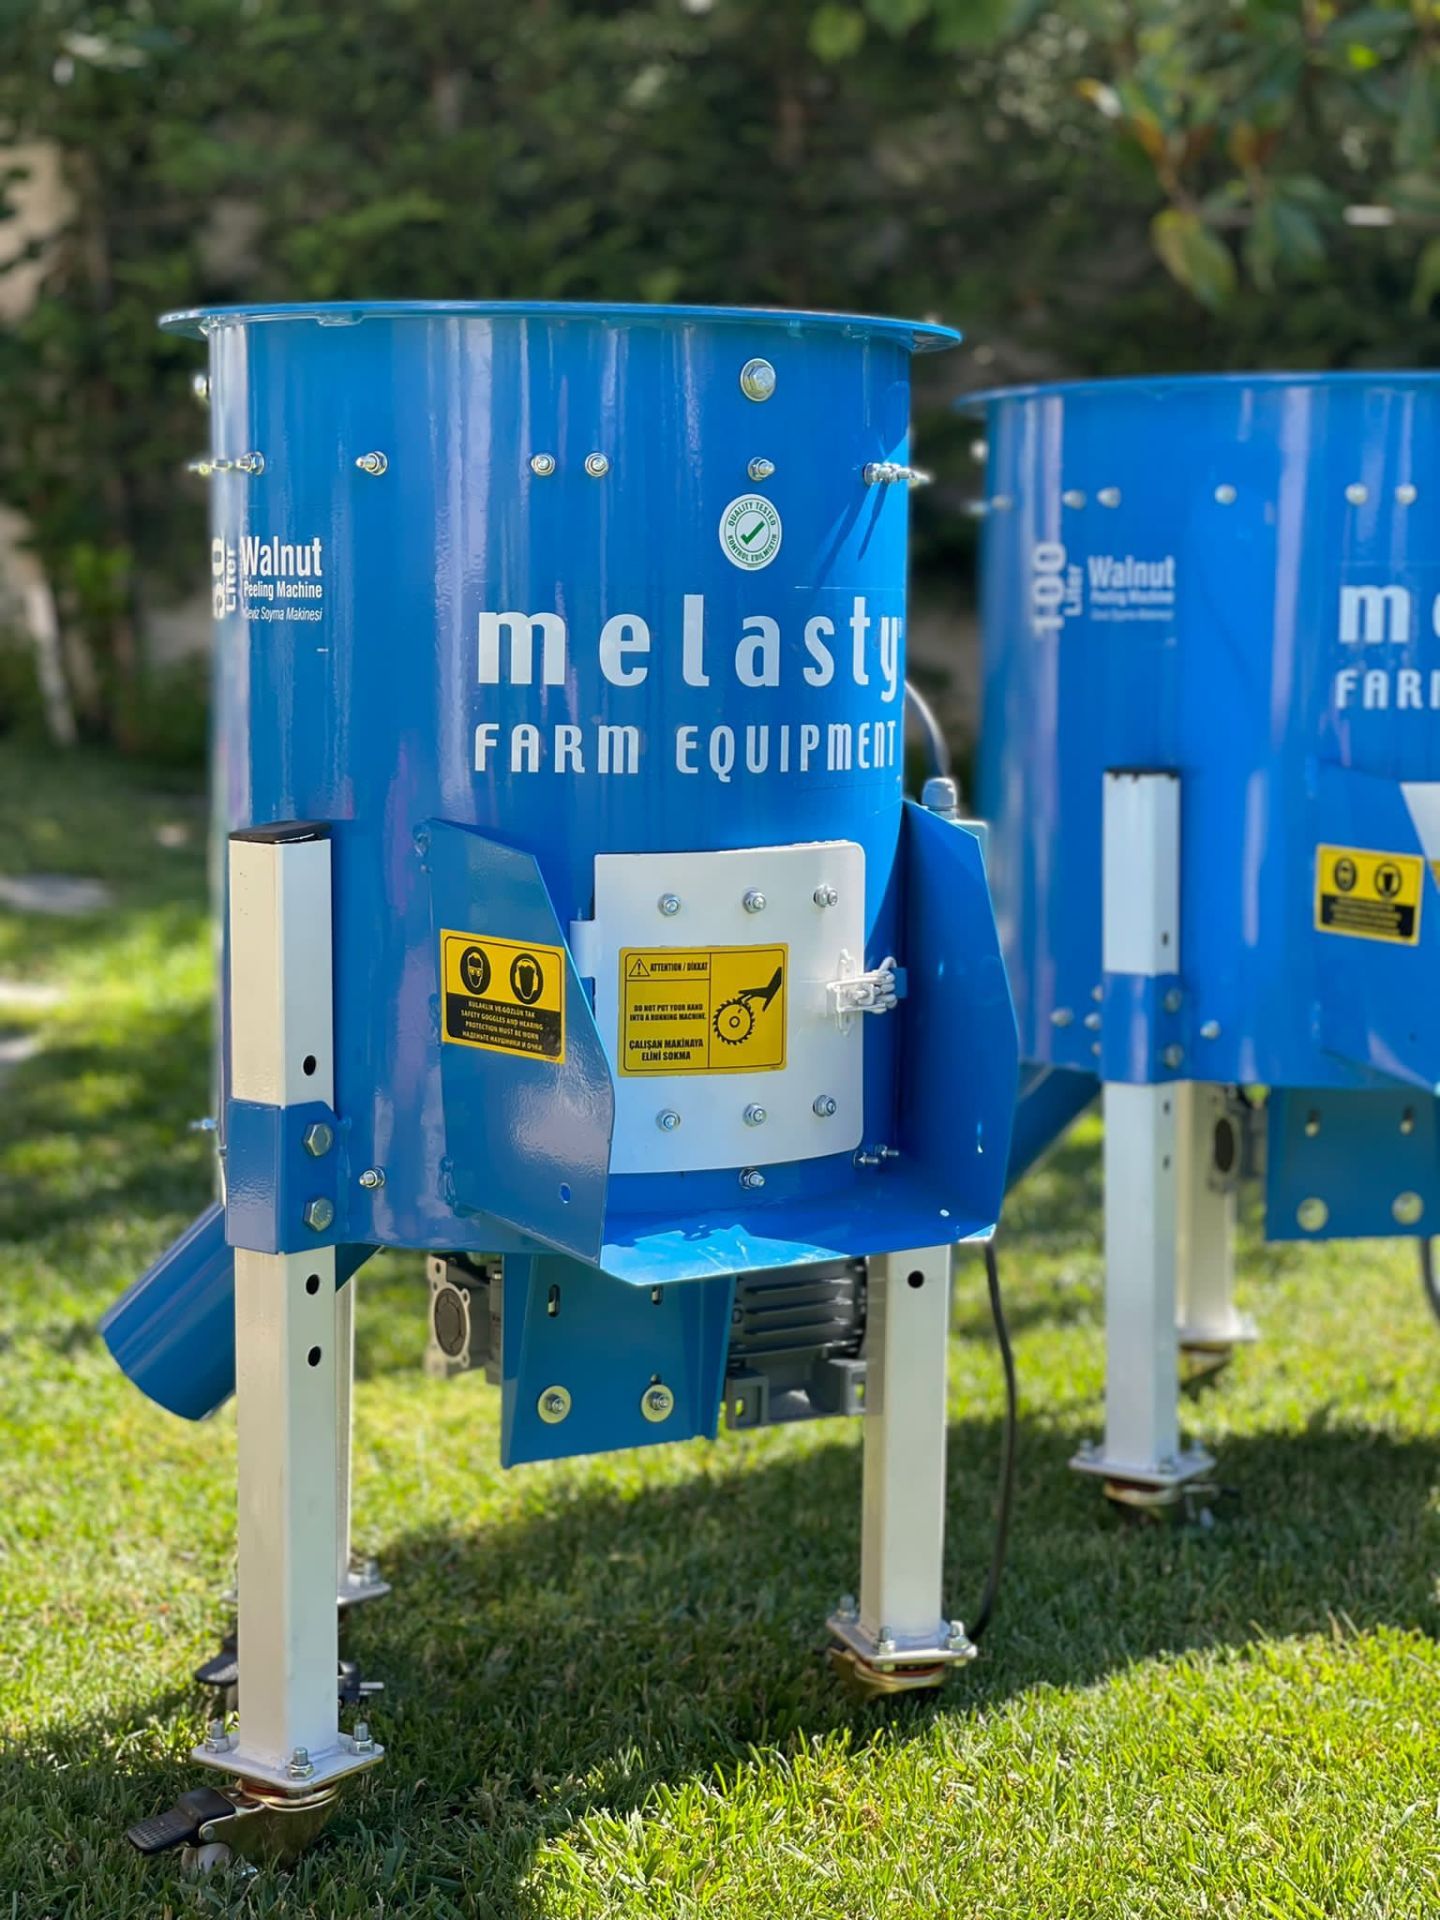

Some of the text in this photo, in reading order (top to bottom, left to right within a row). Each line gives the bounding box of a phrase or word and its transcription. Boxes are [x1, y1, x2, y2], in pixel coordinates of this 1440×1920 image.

[240, 536, 323, 577] Walnut
[1087, 554, 1175, 590] Walnut
[243, 581, 323, 601] Peeling Machine
[1031, 541, 1066, 636] 100
[260, 606, 285, 623] Soyma
[286, 607, 323, 622] Makinesi
[1339, 585, 1440, 644] m
[478, 594, 901, 702] melasty
[474, 720, 897, 782] FARM EQUIPMENT
[650, 963, 682, 972] ATTENTION
[460, 1009, 481, 1019] SAFETY
[481, 1013, 506, 1024] GOGGLES
[633, 1004, 643, 1012] DO
[643, 1004, 656, 1012] NOT
[656, 1004, 669, 1012] PUT
[669, 1004, 686, 1012] YOUR
[465, 1020, 498, 1033] PROTECTION
[629, 1037, 704, 1051] ÇALIŞAN MAKİNAYA
[641, 1050, 691, 1062] ELİNİ SOKMA
